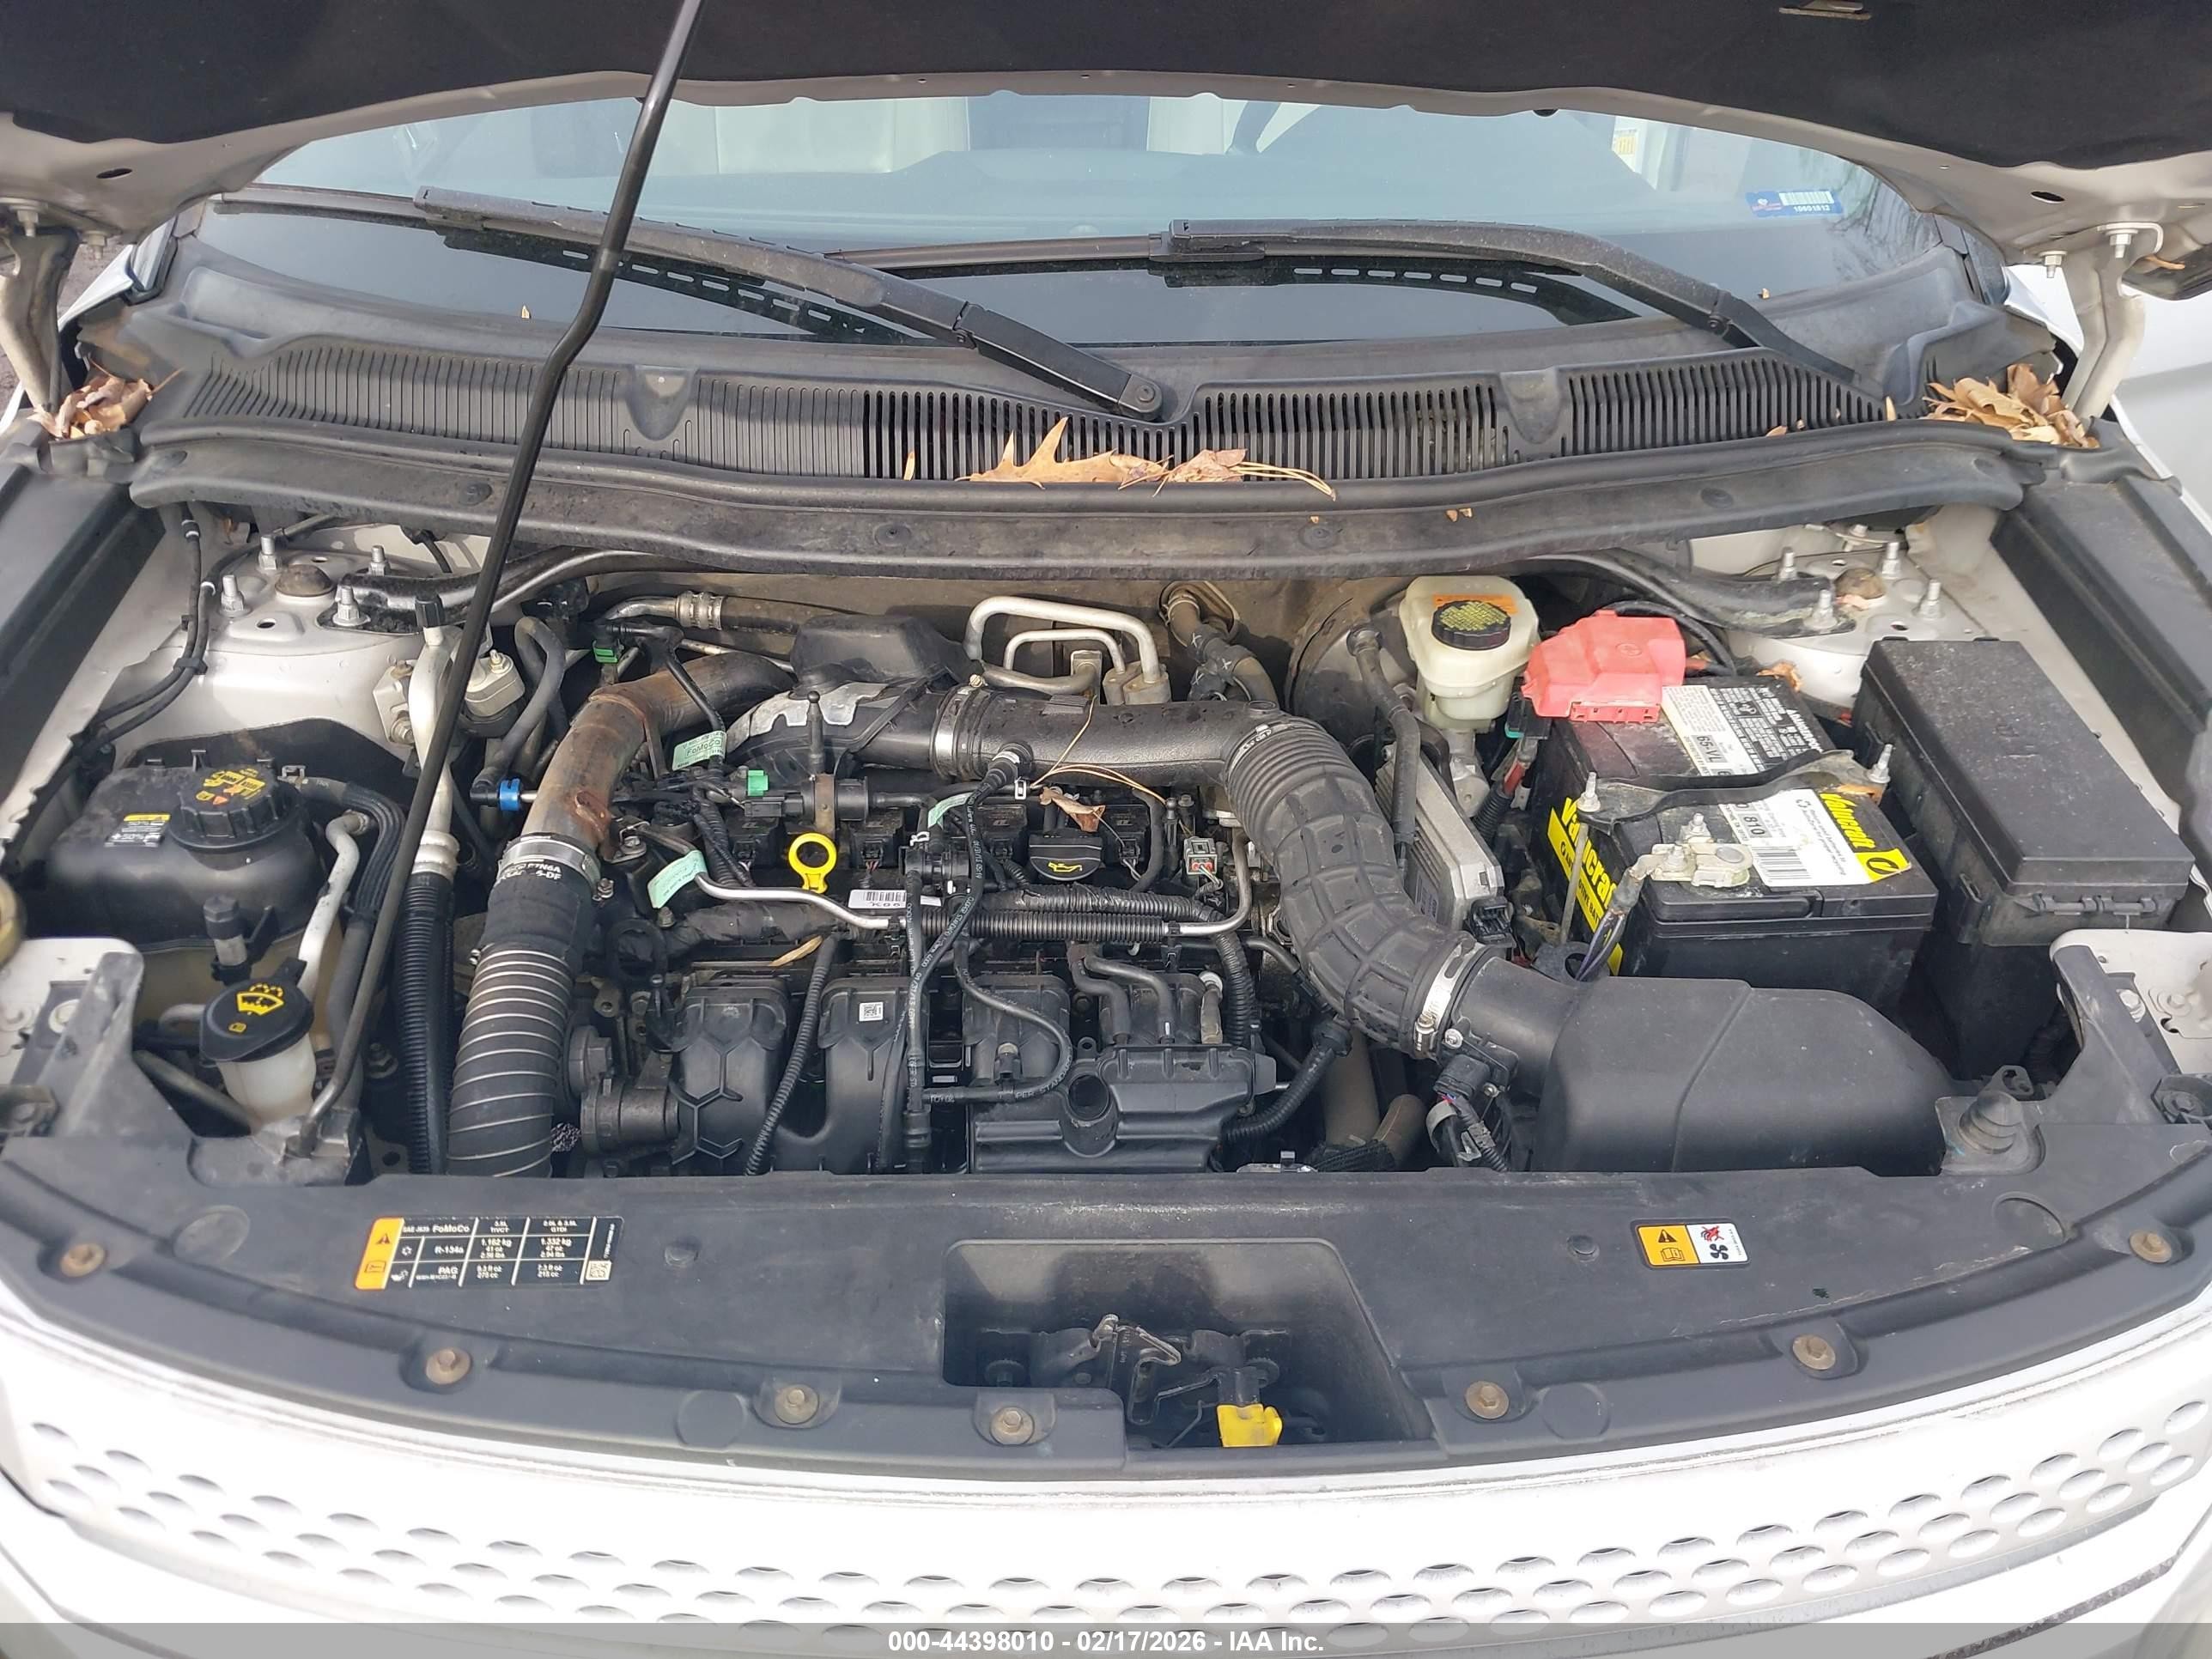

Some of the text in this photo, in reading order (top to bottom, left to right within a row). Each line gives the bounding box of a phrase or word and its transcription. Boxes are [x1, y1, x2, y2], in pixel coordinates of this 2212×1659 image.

[1744, 817, 1765, 836] 810
[433, 1224, 470, 1233] FoMoCo
[502, 1238, 513, 1249] kg
[561, 1237, 572, 1249] kg
[438, 1267, 458, 1275] PAG
